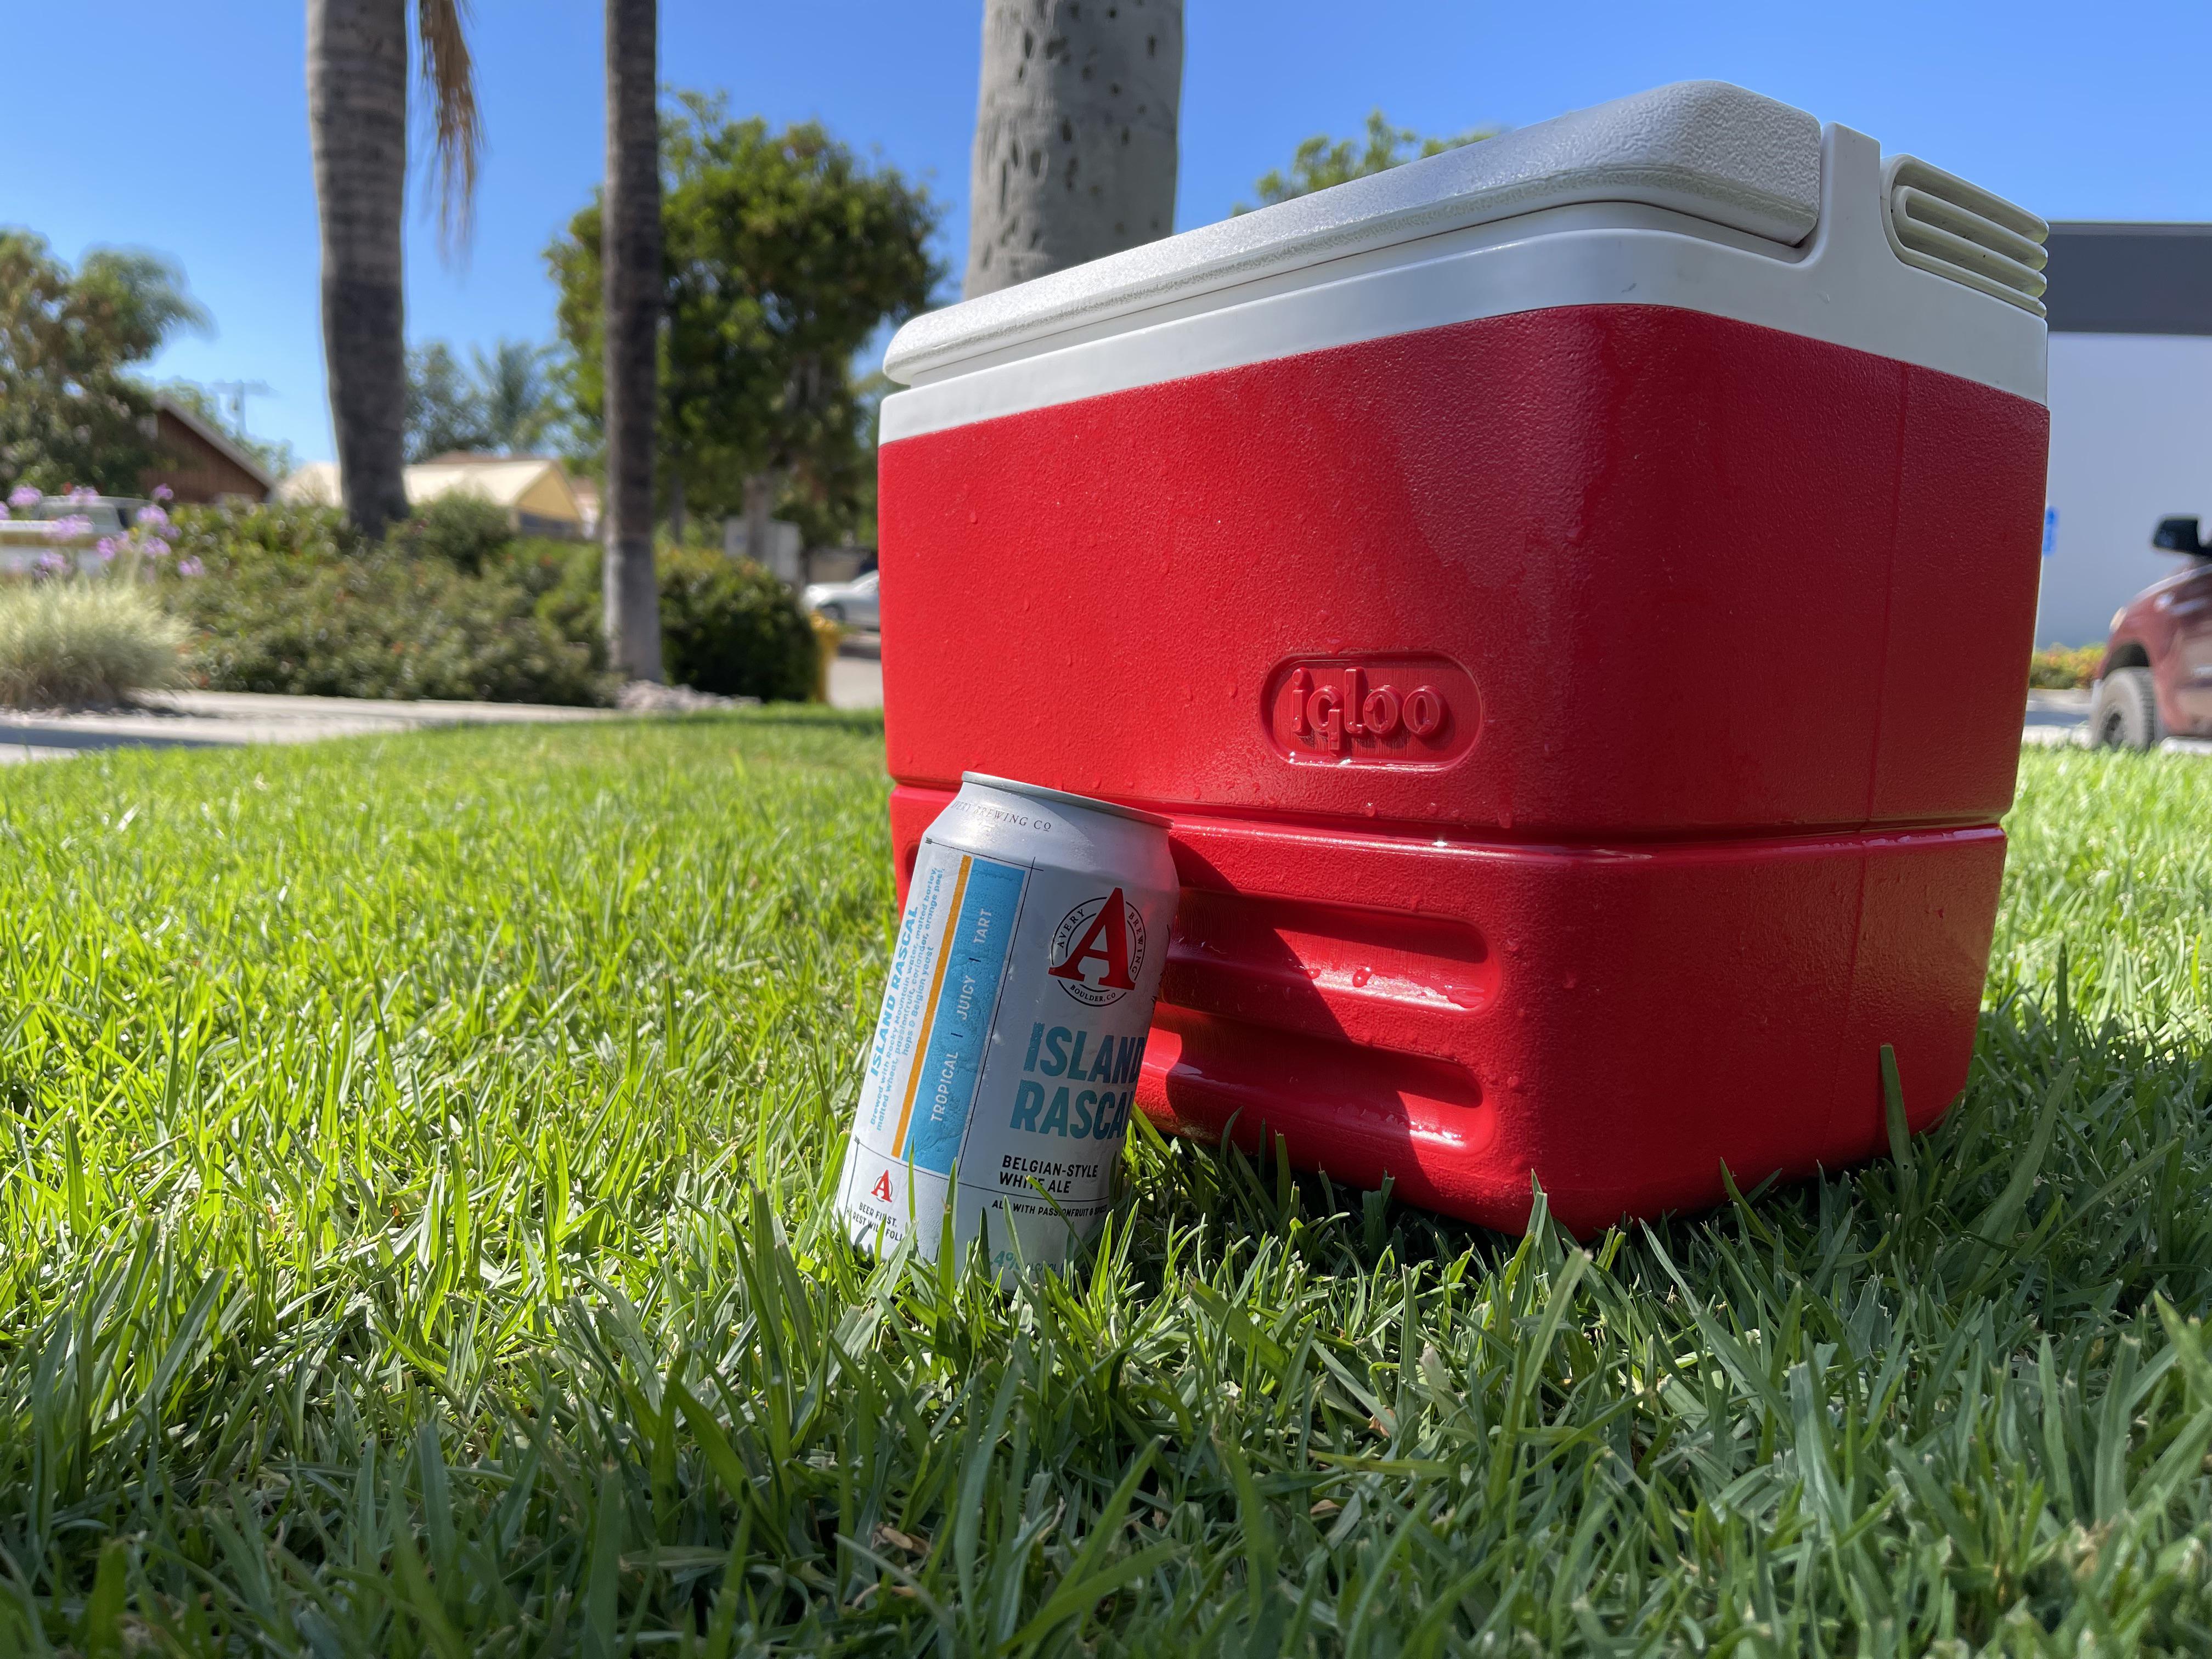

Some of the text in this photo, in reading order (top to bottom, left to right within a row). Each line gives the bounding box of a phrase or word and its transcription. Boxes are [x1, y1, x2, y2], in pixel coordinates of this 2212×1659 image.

[1292, 667, 1441, 752] igloo
[974, 805, 1028, 826] BREWING
[1048, 887, 1136, 990] A
[1057, 909, 1143, 974] AVERY BREWING
[870, 1086, 883, 1125] Brewed
[881, 1061, 889, 1084] with
[887, 1028, 899, 1058] Rocky
[894, 978, 910, 1024] Mountain
[916, 904, 927, 939] malted
[871, 906, 918, 1076] ISLAND RASCAL
[877, 1094, 889, 1131] malted
[886, 1058, 899, 1091] wheat,
[912, 934, 929, 984] coriander,
[926, 895, 937, 929] orange
[902, 1030, 913, 1056] hops
[911, 979, 926, 1017] Belgian
[922, 946, 934, 975] yeast
[930, 909, 992, 1121] TROPICAL JUICY TART
[1023, 1022, 1146, 1084] ISLAND
[871, 1169, 892, 1203] A
[1002, 1155, 1098, 1178] BELGIAN-STYLE
[1047, 1180, 1071, 1193] ALE
[853, 1212, 867, 1226] REST
[868, 1219, 879, 1232] WIL
[859, 1202, 874, 1217] BEER
[1013, 1203, 1035, 1214] WITH
[1038, 1206, 1088, 1217] PASSONFRUIT
